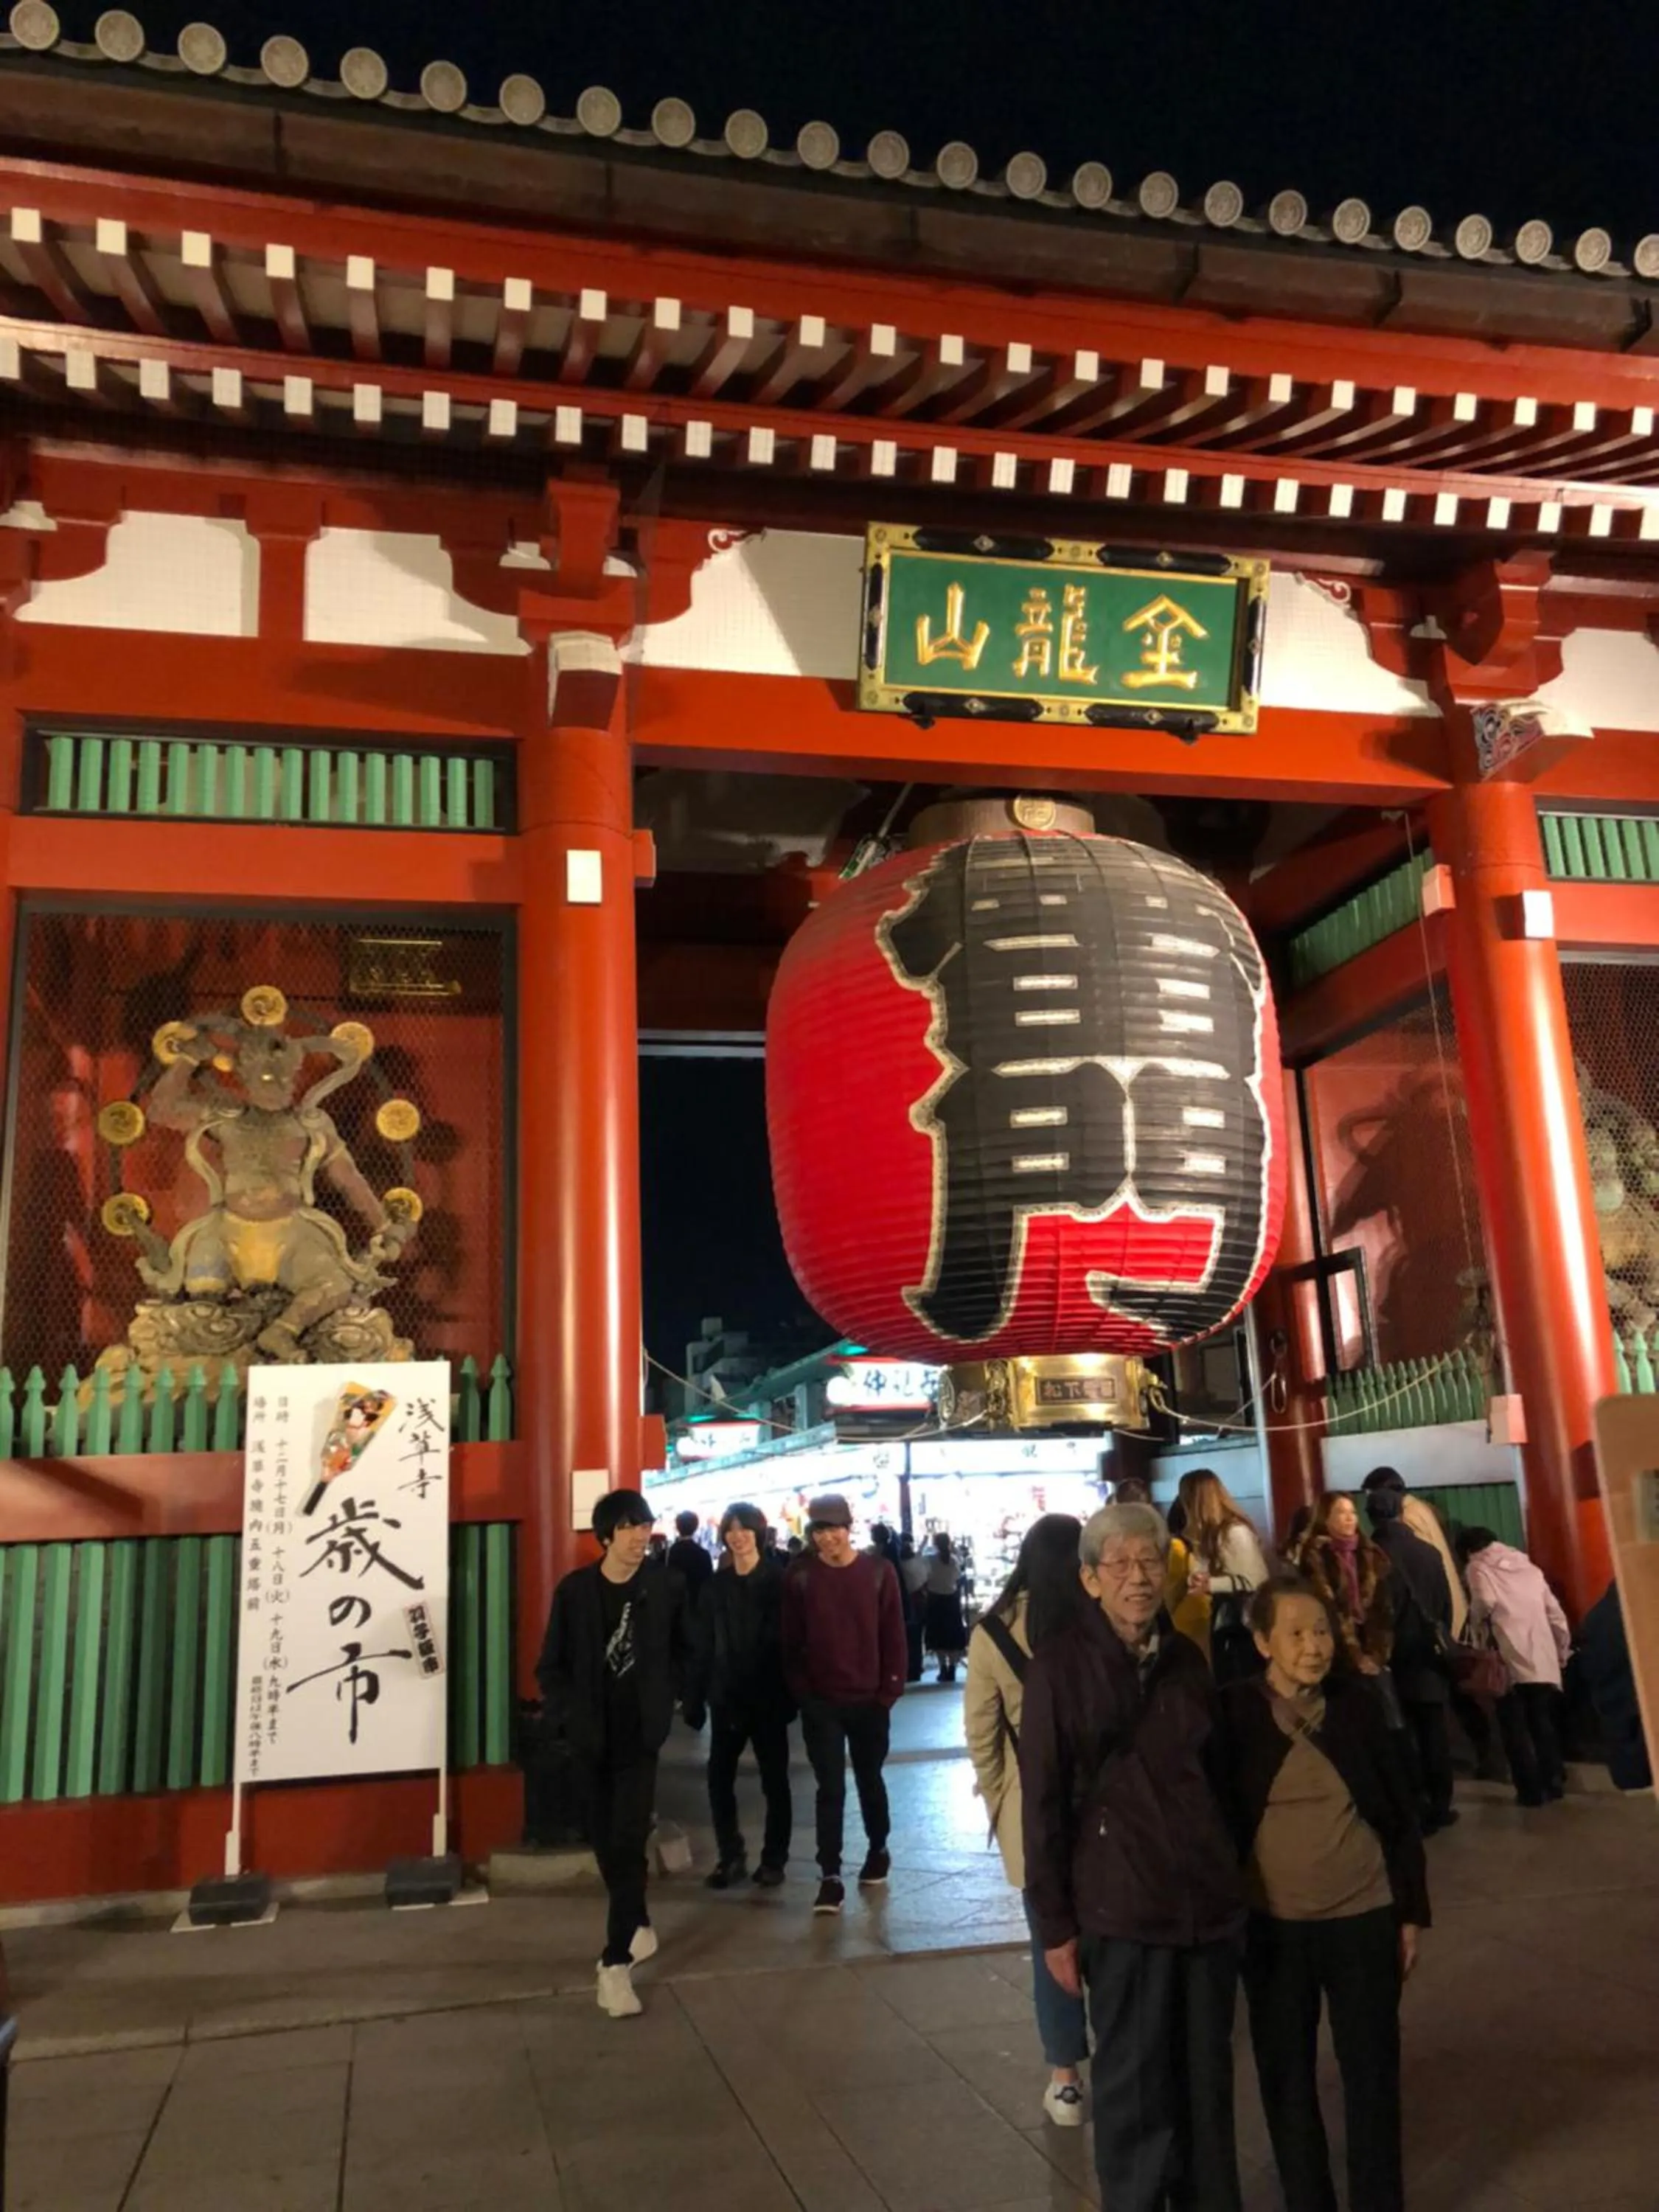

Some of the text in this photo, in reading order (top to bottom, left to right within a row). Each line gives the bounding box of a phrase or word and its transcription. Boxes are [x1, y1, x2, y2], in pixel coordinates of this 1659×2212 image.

[915, 580, 1210, 690] 金龍山
[397, 1397, 446, 1500] 浅草寺
[285, 1497, 426, 1745] 歳の市
